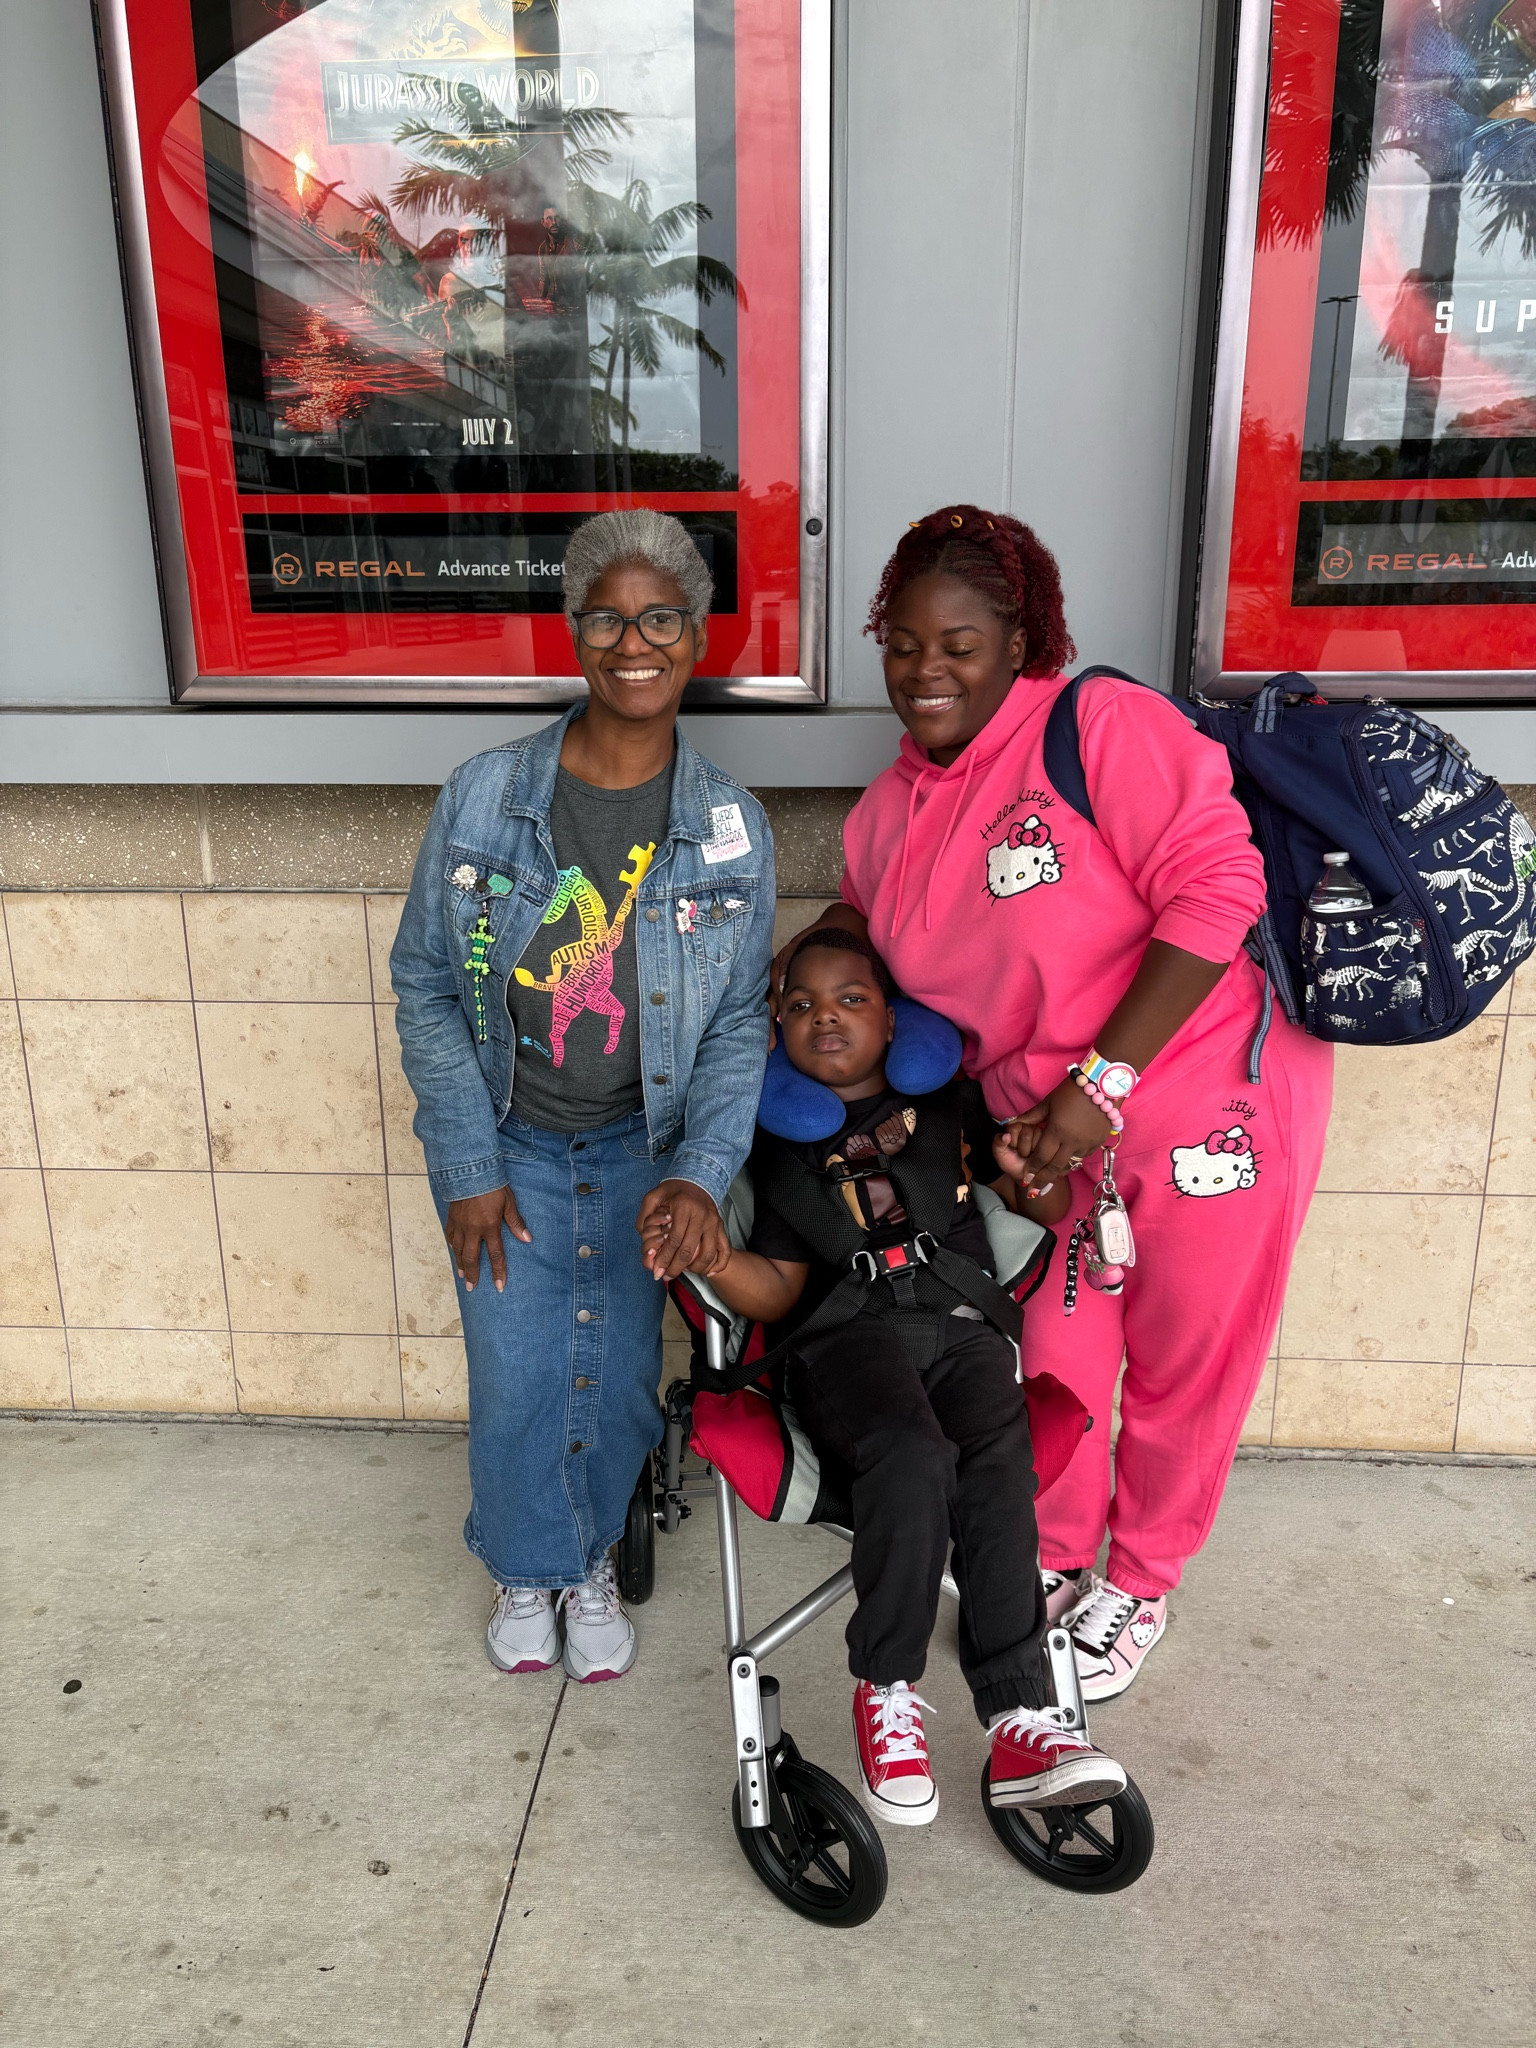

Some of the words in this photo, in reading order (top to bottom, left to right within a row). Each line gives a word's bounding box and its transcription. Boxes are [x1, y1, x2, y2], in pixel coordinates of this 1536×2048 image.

[334, 69, 467, 115] JURASSIC
[475, 66, 600, 112] WORLD
[462, 418, 496, 446] JULY
[503, 417, 514, 445] 2
[315, 560, 426, 577] REGAL
[437, 559, 511, 577] Advance
[1367, 552, 1488, 571] REGAL
[979, 803, 1017, 841] Hello
[1016, 787, 1056, 810] Kitty
[547, 866, 582, 922] INTELLIGENT
[619, 890, 634, 916] STRONG
[572, 884, 598, 941] CURIOUS
[609, 919, 625, 949] SPECIAL
[552, 941, 610, 966] AUTISM
[533, 982, 556, 991] BRAVE
[554, 960, 589, 1005] CELEBRATE
[562, 953, 612, 1013] HUMOROUS
[589, 968, 613, 999] KINDNESS
[585, 998, 614, 1015] CREATIVE
[597, 989, 624, 1013] UNIQUE
[551, 1012, 571, 1038] GIFTED
[610, 1013, 624, 1032] LOVE
[553, 1040, 564, 1067] BRIGHT
[604, 1034, 619, 1053] PEACE
[1222, 1099, 1258, 1121] itty
